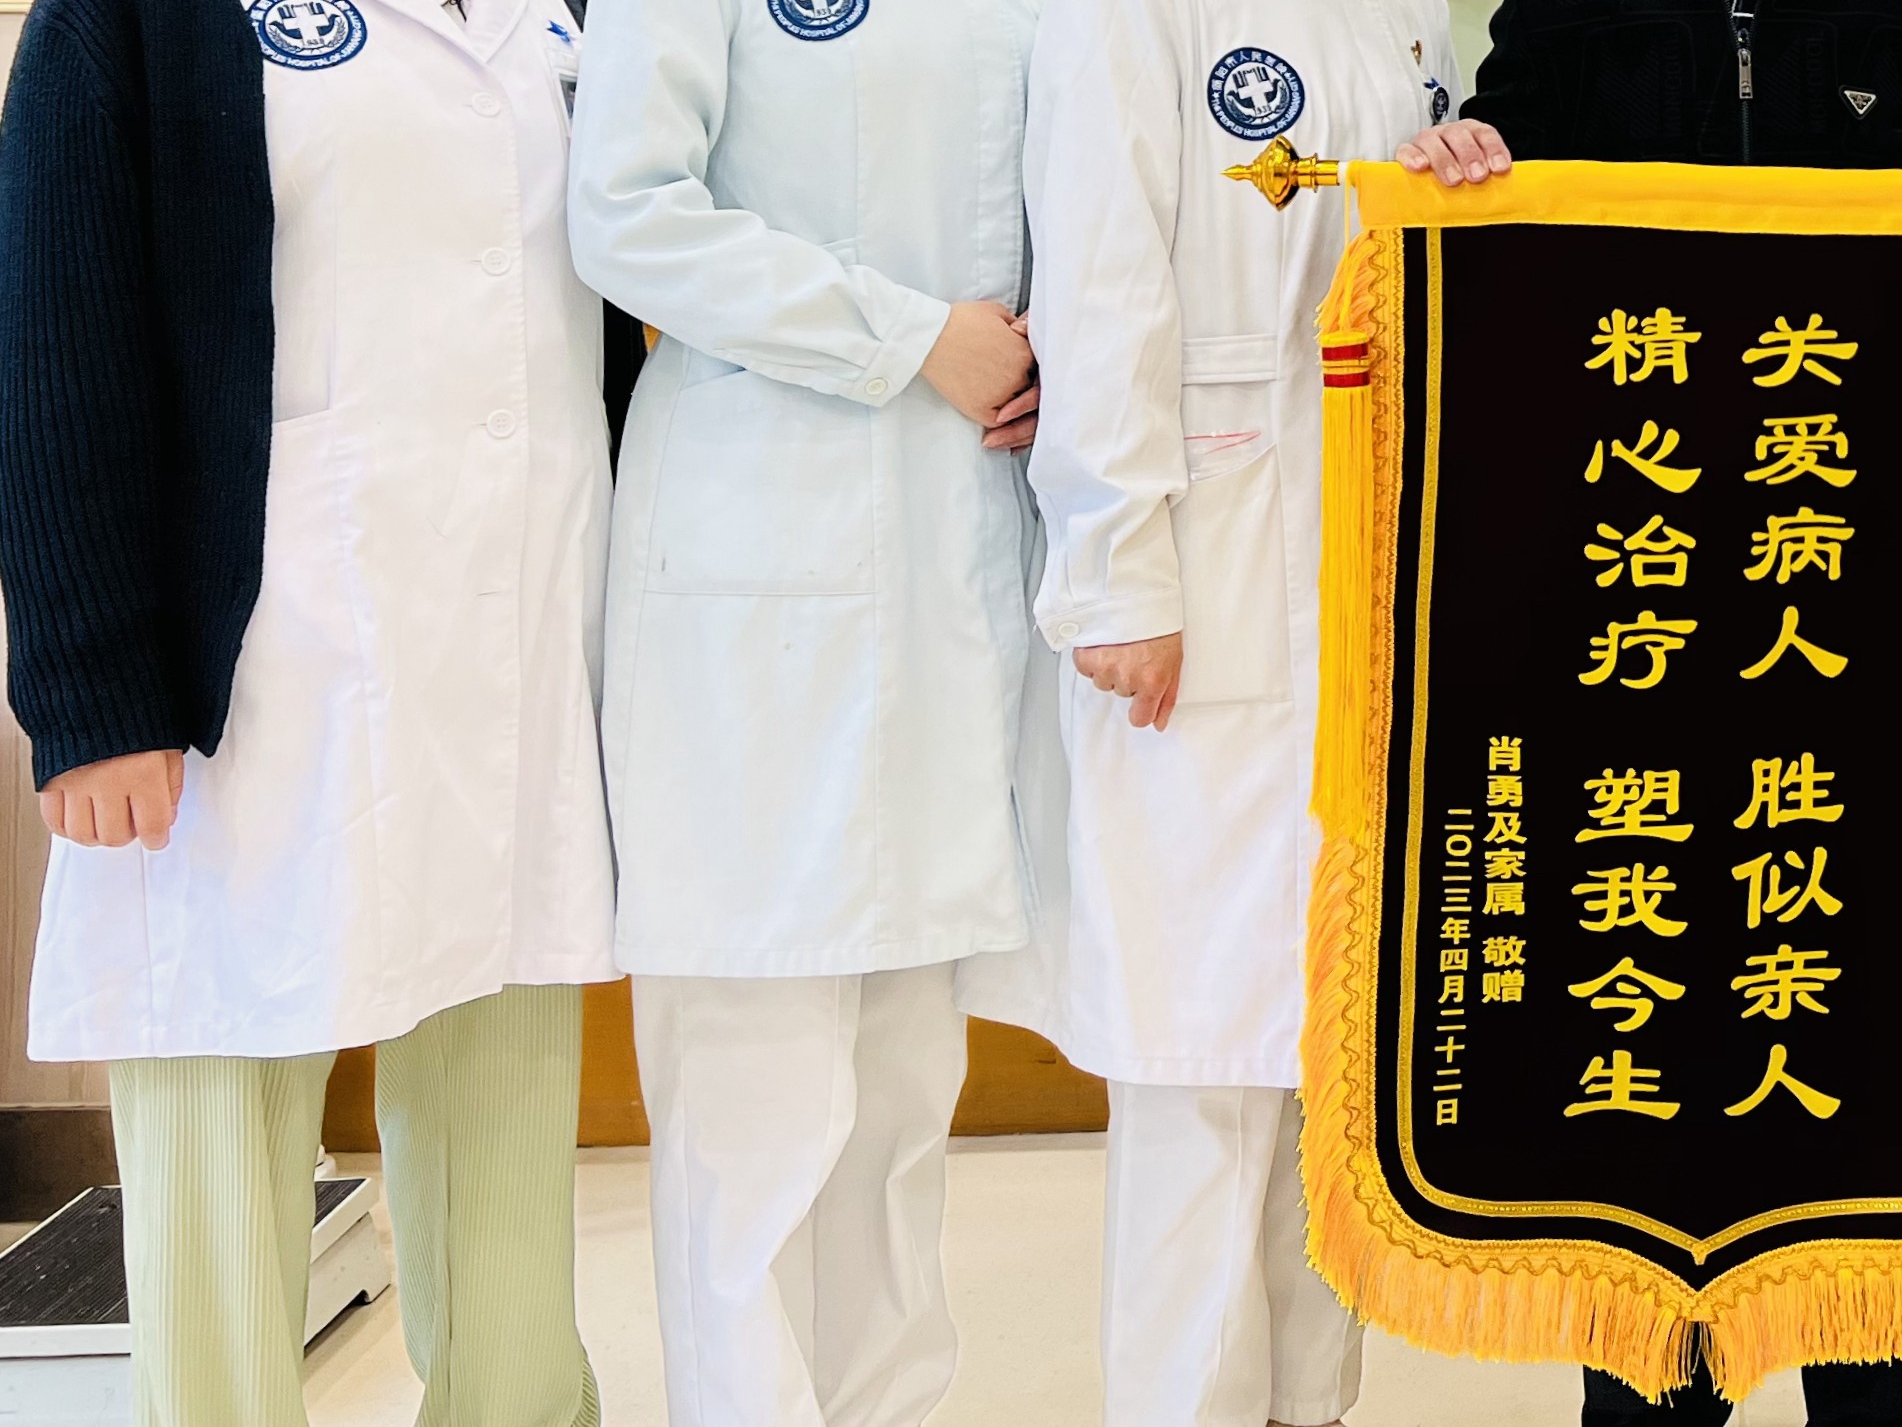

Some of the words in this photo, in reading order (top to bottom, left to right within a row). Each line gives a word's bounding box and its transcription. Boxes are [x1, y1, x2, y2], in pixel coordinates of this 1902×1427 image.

[1577, 307, 1701, 690] 精心治疗
[1740, 313, 1858, 679] 关爱病人
[1482, 735, 1527, 915] 肖勇及家属
[1482, 935, 1527, 1003] 敬赠
[1563, 767, 1694, 1120] 塑我今生
[1724, 752, 1845, 1120] 胜似亲人
